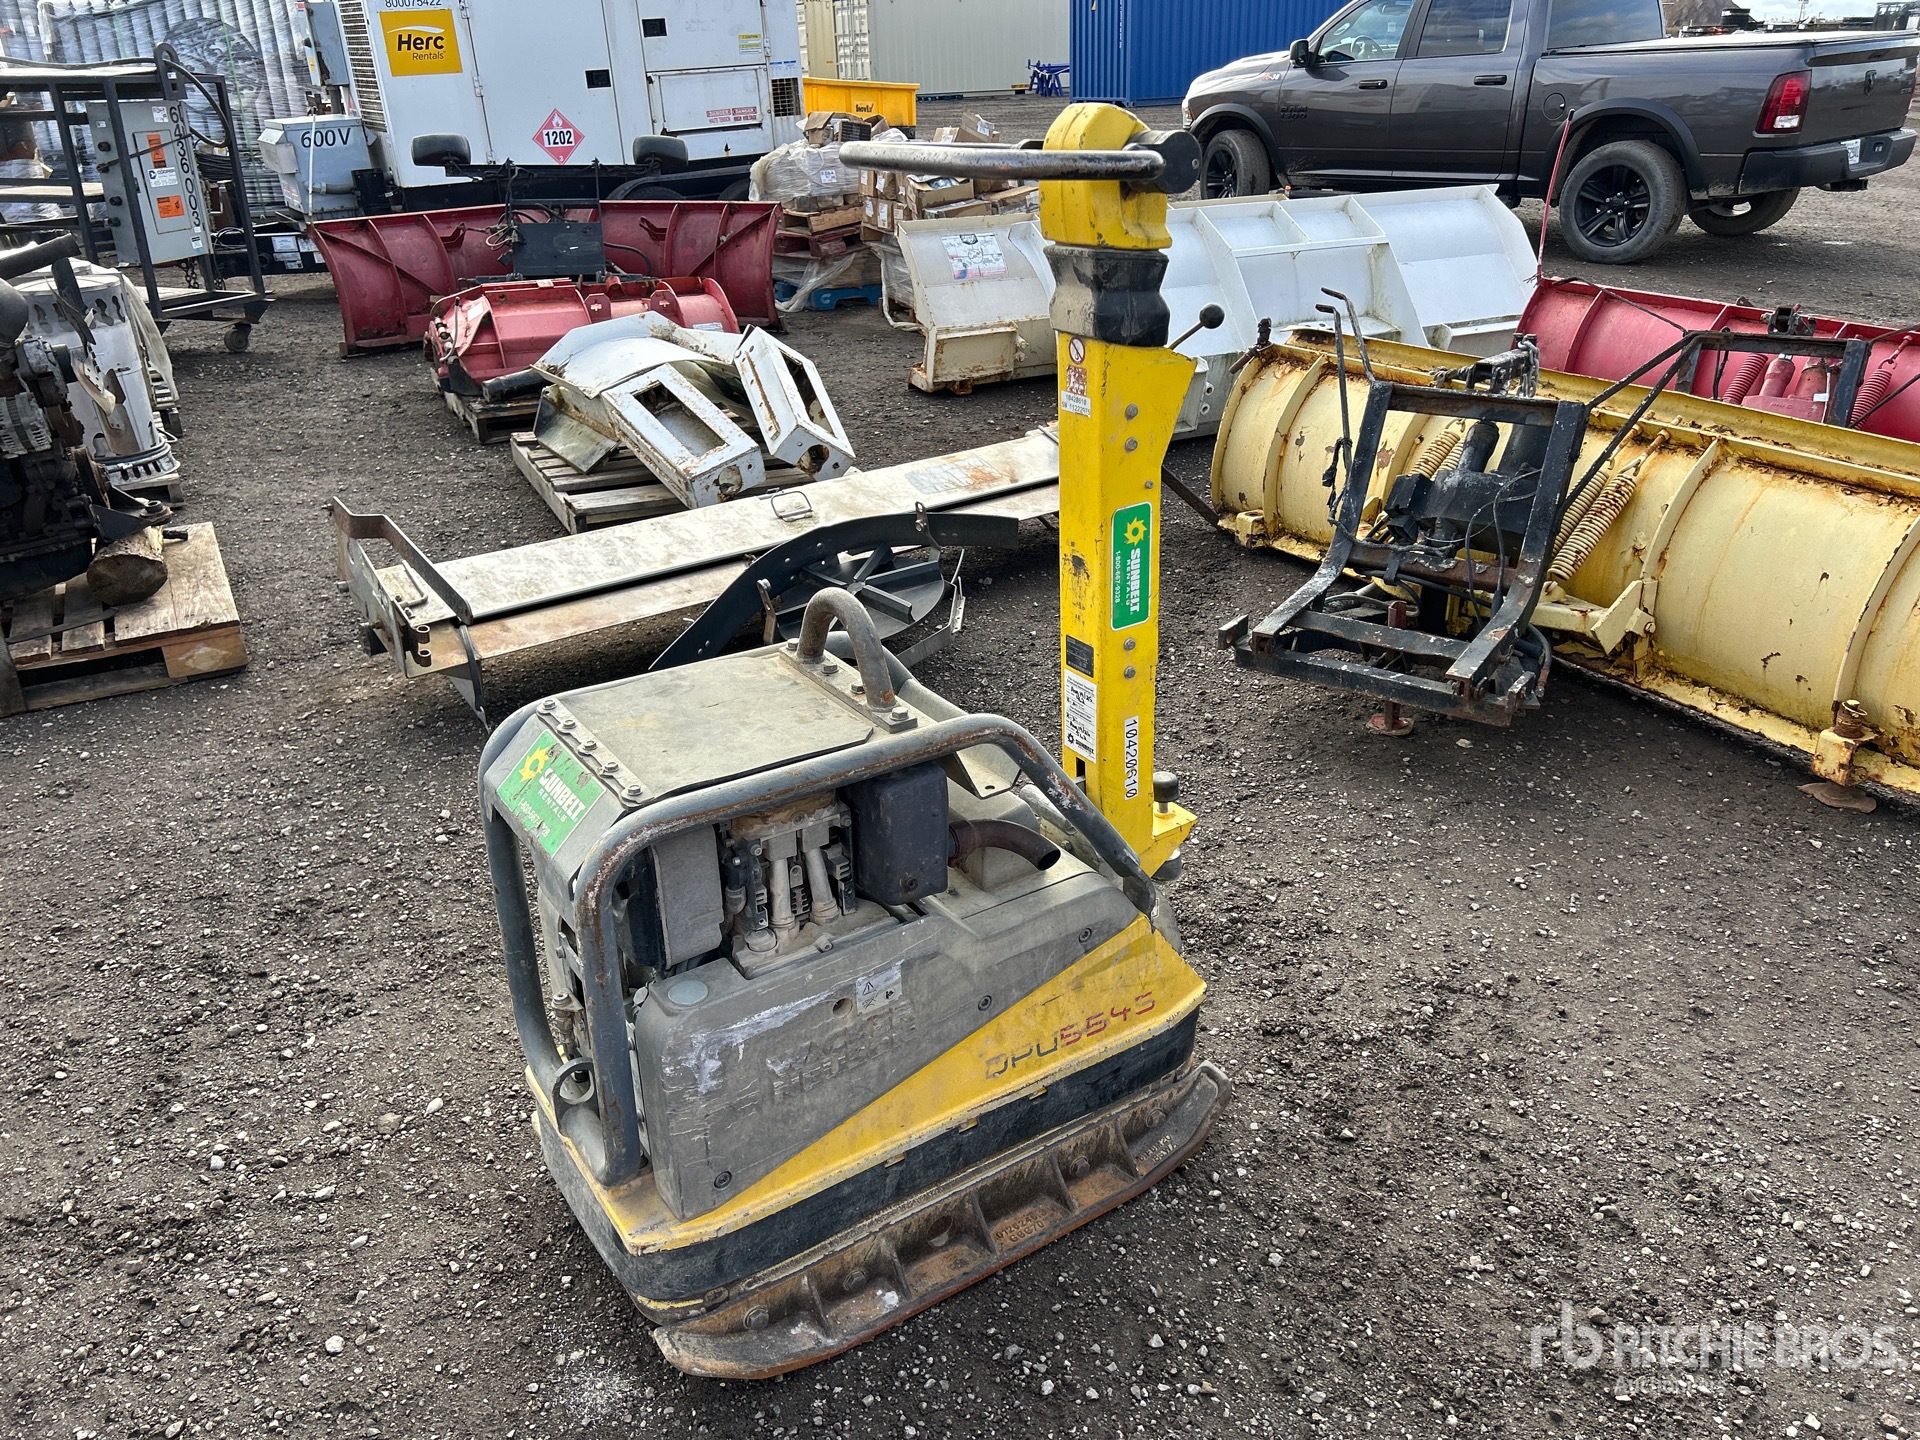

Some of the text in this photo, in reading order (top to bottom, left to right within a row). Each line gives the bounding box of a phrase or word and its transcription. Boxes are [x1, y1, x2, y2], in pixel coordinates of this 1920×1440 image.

[397, 33, 445, 52] Herc
[544, 130, 573, 146] 1202
[1130, 547, 1141, 612] SUNBELT
[537, 788, 568, 822] RENTALS
[538, 767, 586, 820] SUNBELT
